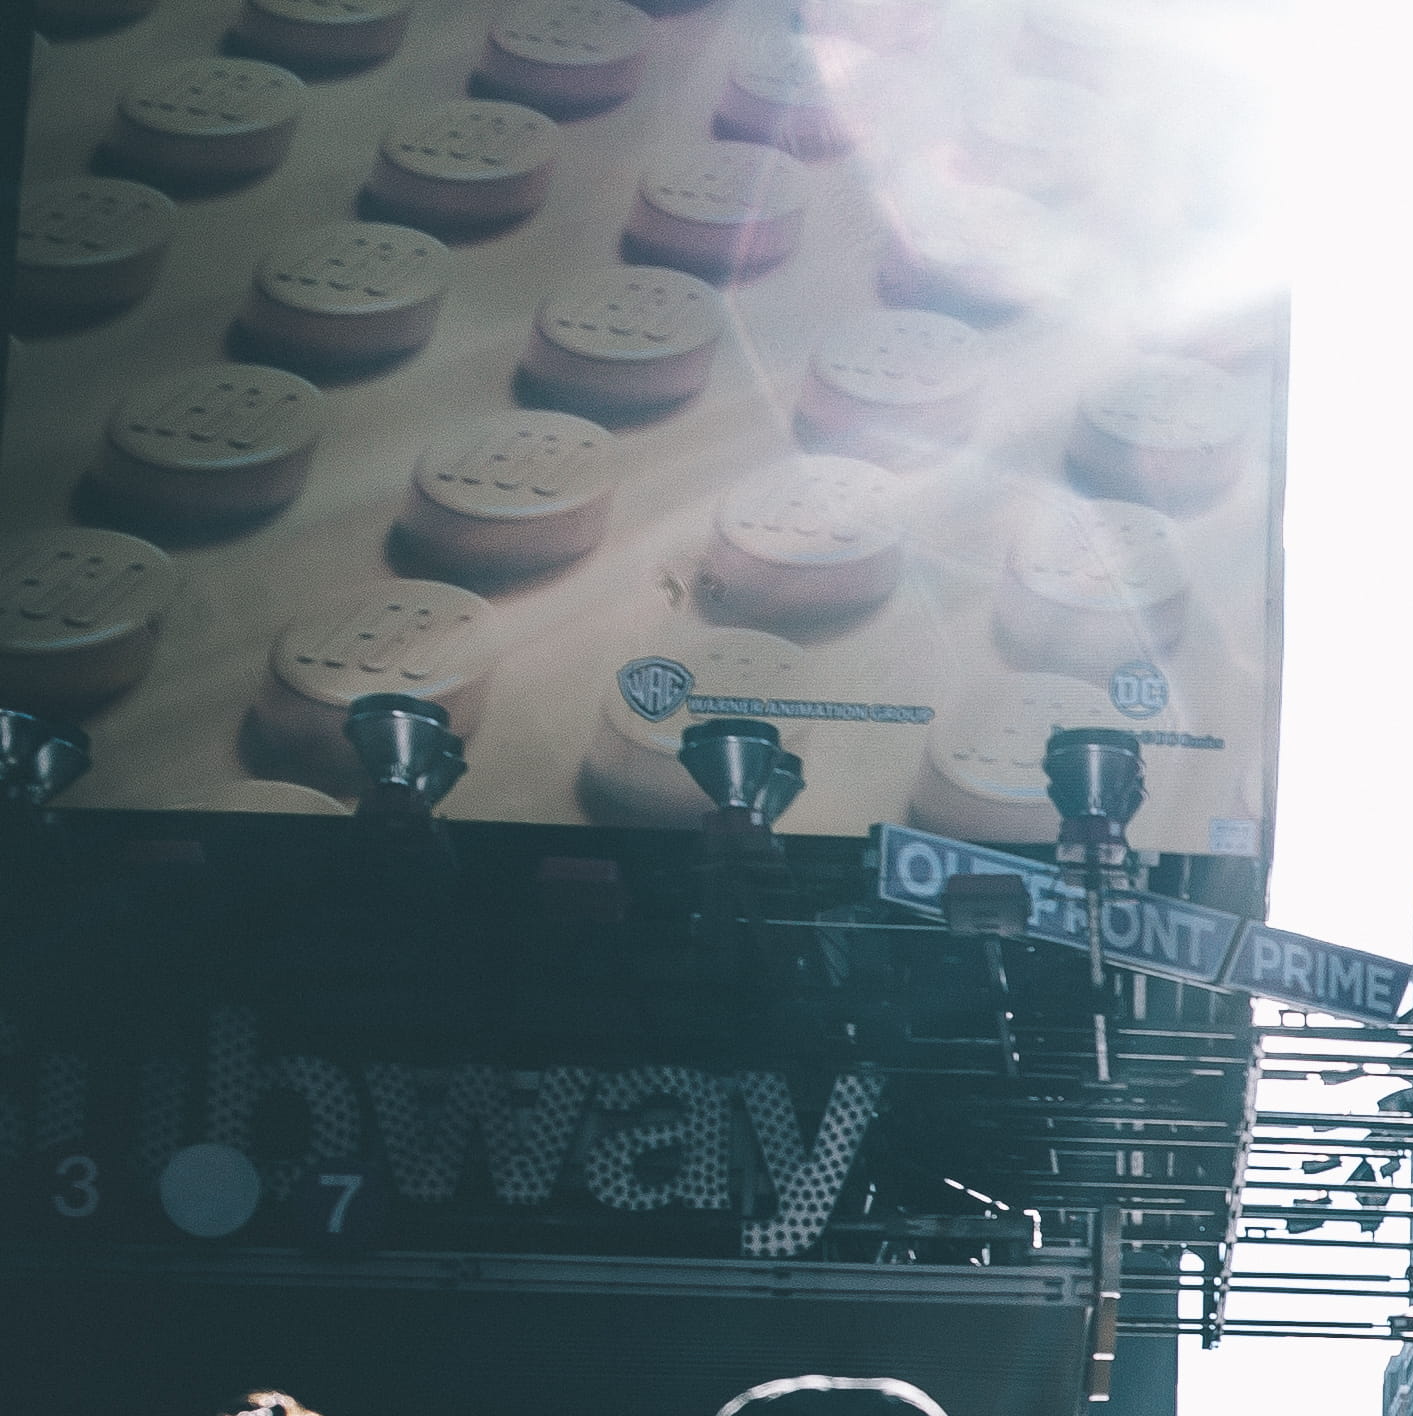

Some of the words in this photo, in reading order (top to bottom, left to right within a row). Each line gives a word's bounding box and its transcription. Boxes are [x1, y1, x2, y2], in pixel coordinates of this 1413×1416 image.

[1114, 674, 1164, 706] DC
[1251, 934, 1396, 1016] PRIME
[0, 1003, 886, 1257] ubway
[52, 1153, 100, 1219] 3
[318, 1173, 364, 1234] 7
